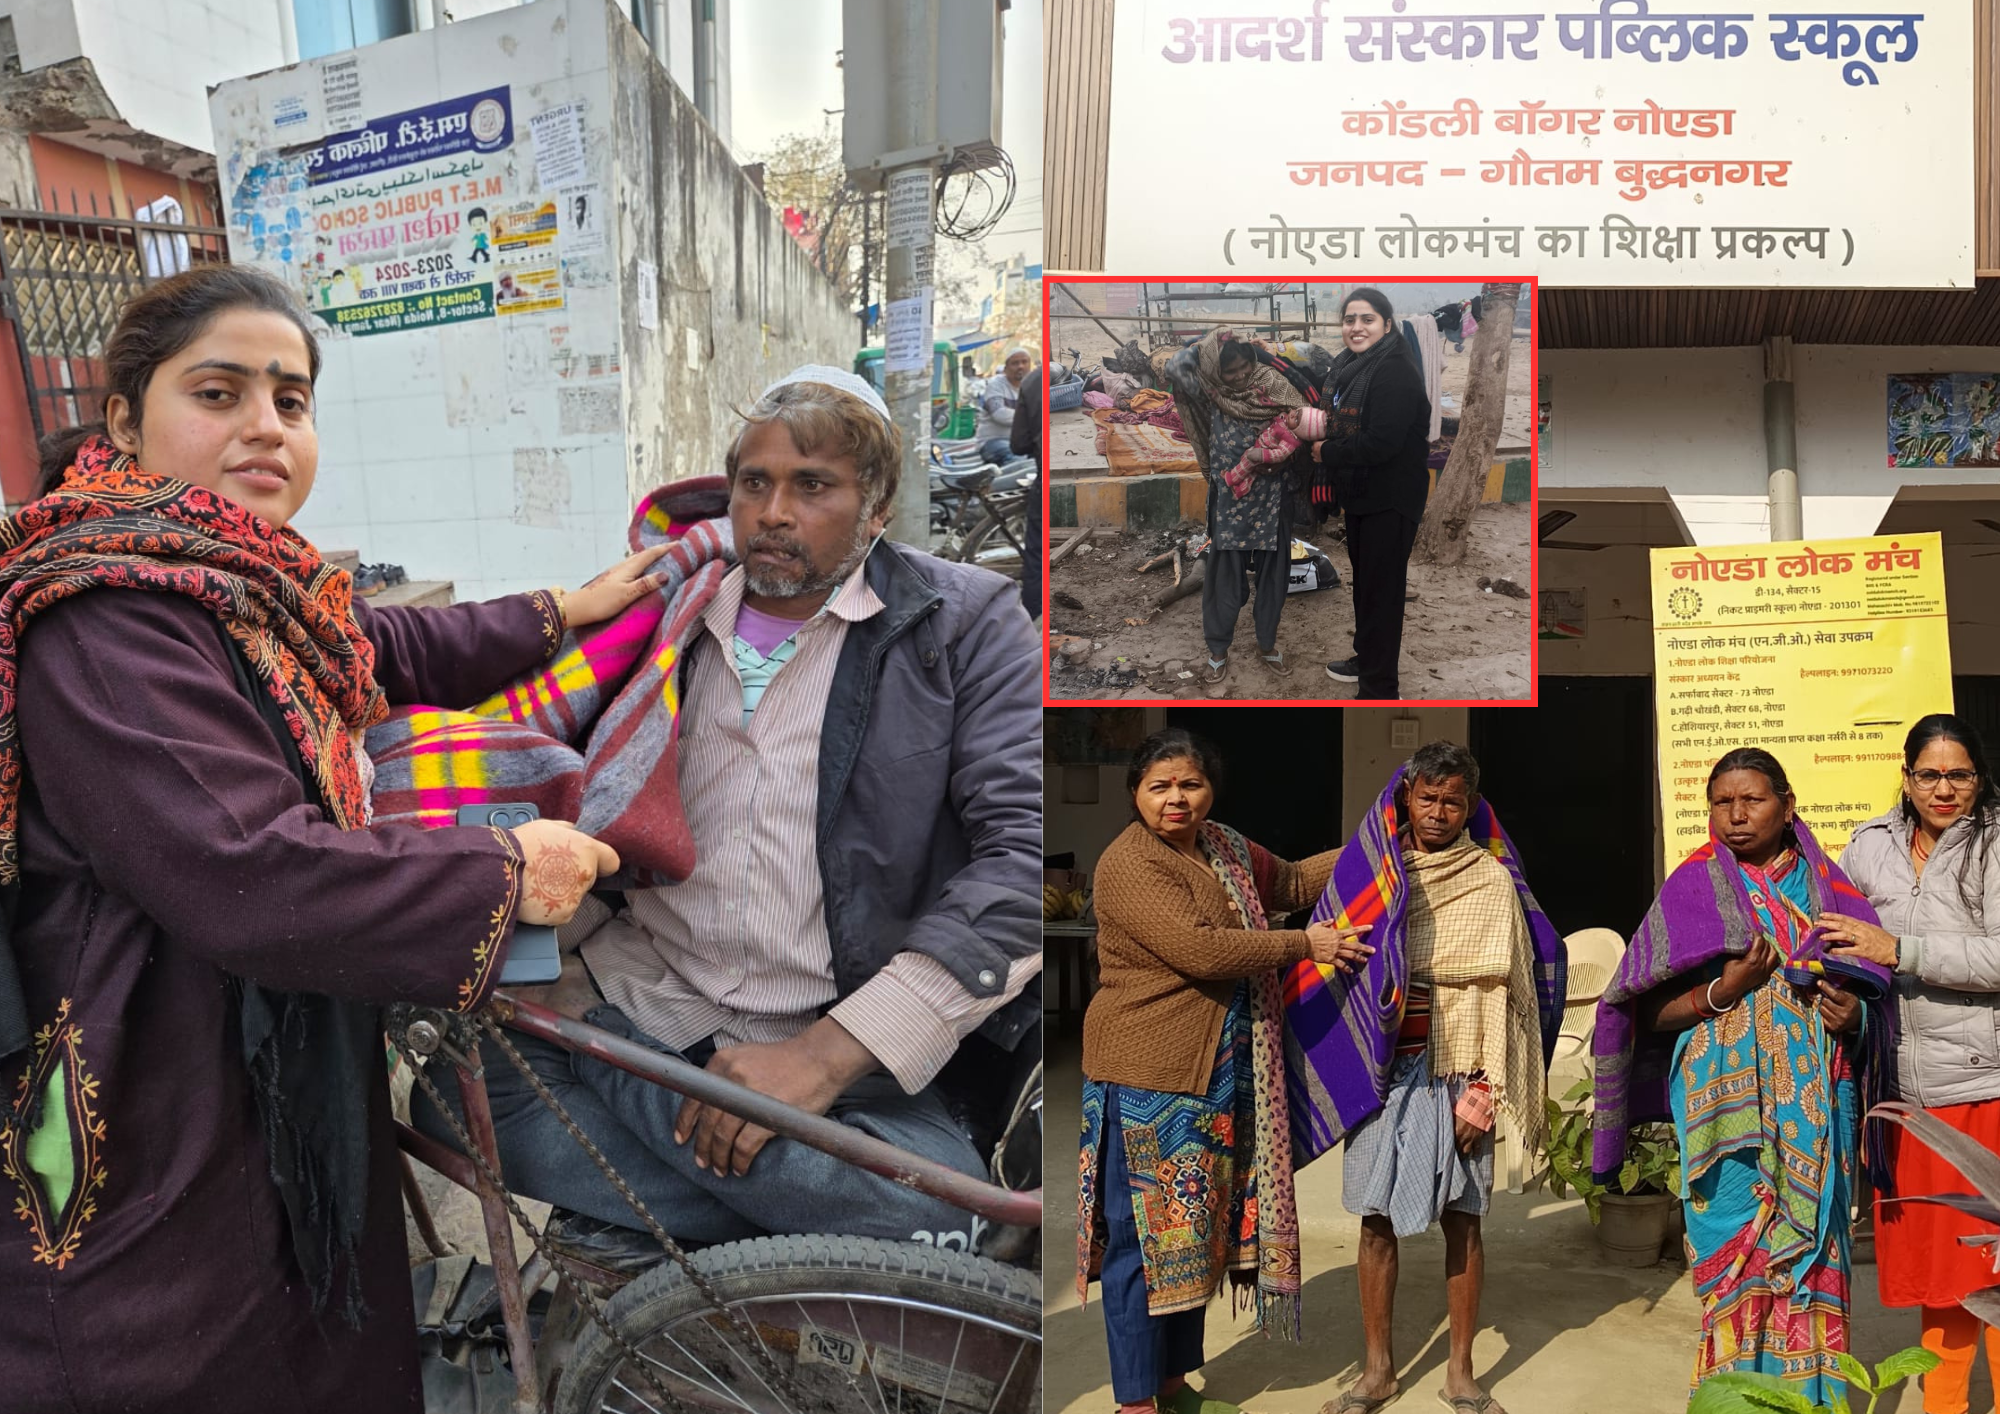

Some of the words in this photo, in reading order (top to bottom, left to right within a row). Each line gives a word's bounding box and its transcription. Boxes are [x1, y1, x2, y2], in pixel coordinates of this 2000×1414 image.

[1161, 0, 1329, 63] आदर्श
[1343, 0, 1545, 62] संस्कार
[1555, 0, 1755, 62] पब्लिक
[1768, 13, 1925, 86] स्कूल
[1341, 97, 1482, 139] कोंडली
[1494, 98, 1603, 137] बॉगर
[1613, 98, 1736, 138] नोएडा
[1286, 160, 1429, 188] जनपद
[1479, 148, 1603, 187] गौतम
[1615, 158, 1793, 201] बुद्धनगर
[1248, 214, 1364, 264] नोएडा
[1376, 215, 1523, 260] लोकमंच
[1537, 225, 1588, 259] का
[1599, 215, 1703, 261] शिक्षा
[1714, 225, 1828, 260] प्रकल्प
[1671, 552, 1768, 581] नोएडा
[1777, 546, 1855, 578] लोक
[1864, 541, 1922, 572] मंच
[1755, 585, 1783, 597] डी-134,
[1786, 584, 1821, 595] सेक्टर-15
[1717, 605, 1742, 617] (निकट
[1744, 604, 1772, 615] प्राइमरी
[1774, 602, 1797, 615] स्कूल)
[1799, 600, 1822, 611] नोएडा
[1829, 601, 1861, 610] 201301
[1667, 638, 1697, 650] नोएडा
[1701, 636, 1725, 648] लोक
[1729, 635, 1746, 648] मंच
[1814, 631, 1836, 644] सेवा
[1839, 631, 1874, 643] उपक्रम
[1698, 656, 1715, 666] लोक
[1718, 655, 1737, 665] शिक्षा
[1739, 654, 1776, 664] परियोजना
[1668, 674, 1694, 683] संस्कार
[1697, 673, 1725, 682] अध्ययन
[1841, 667, 1893, 676] 9971073220
[1740, 689, 1750, 697] 73
[1752, 686, 1774, 696] नोएडा
[1748, 705, 1762, 714] 68,
[1764, 702, 1786, 712] नोएडा
[1748, 720, 1760, 729] 51,
[1761, 718, 1784, 728] नोएडा
[1672, 738, 1691, 748] (सभी
[1743, 736, 1758, 746] द्वारा
[1760, 736, 1786, 745] मान्यता
[1788, 733, 1805, 743] प्राप्त
[1807, 734, 1825, 742] कक्षा
[1827, 731, 1846, 741] नर्सरी
[1849, 731, 1857, 740] से
[1866, 732, 1883, 741] तक)
[1810, 803, 1832, 813] नोएडा
[1834, 802, 1853, 812] लोक
[1855, 802, 1871, 811] मंच)
[1676, 809, 1700, 820] (नोएडा
